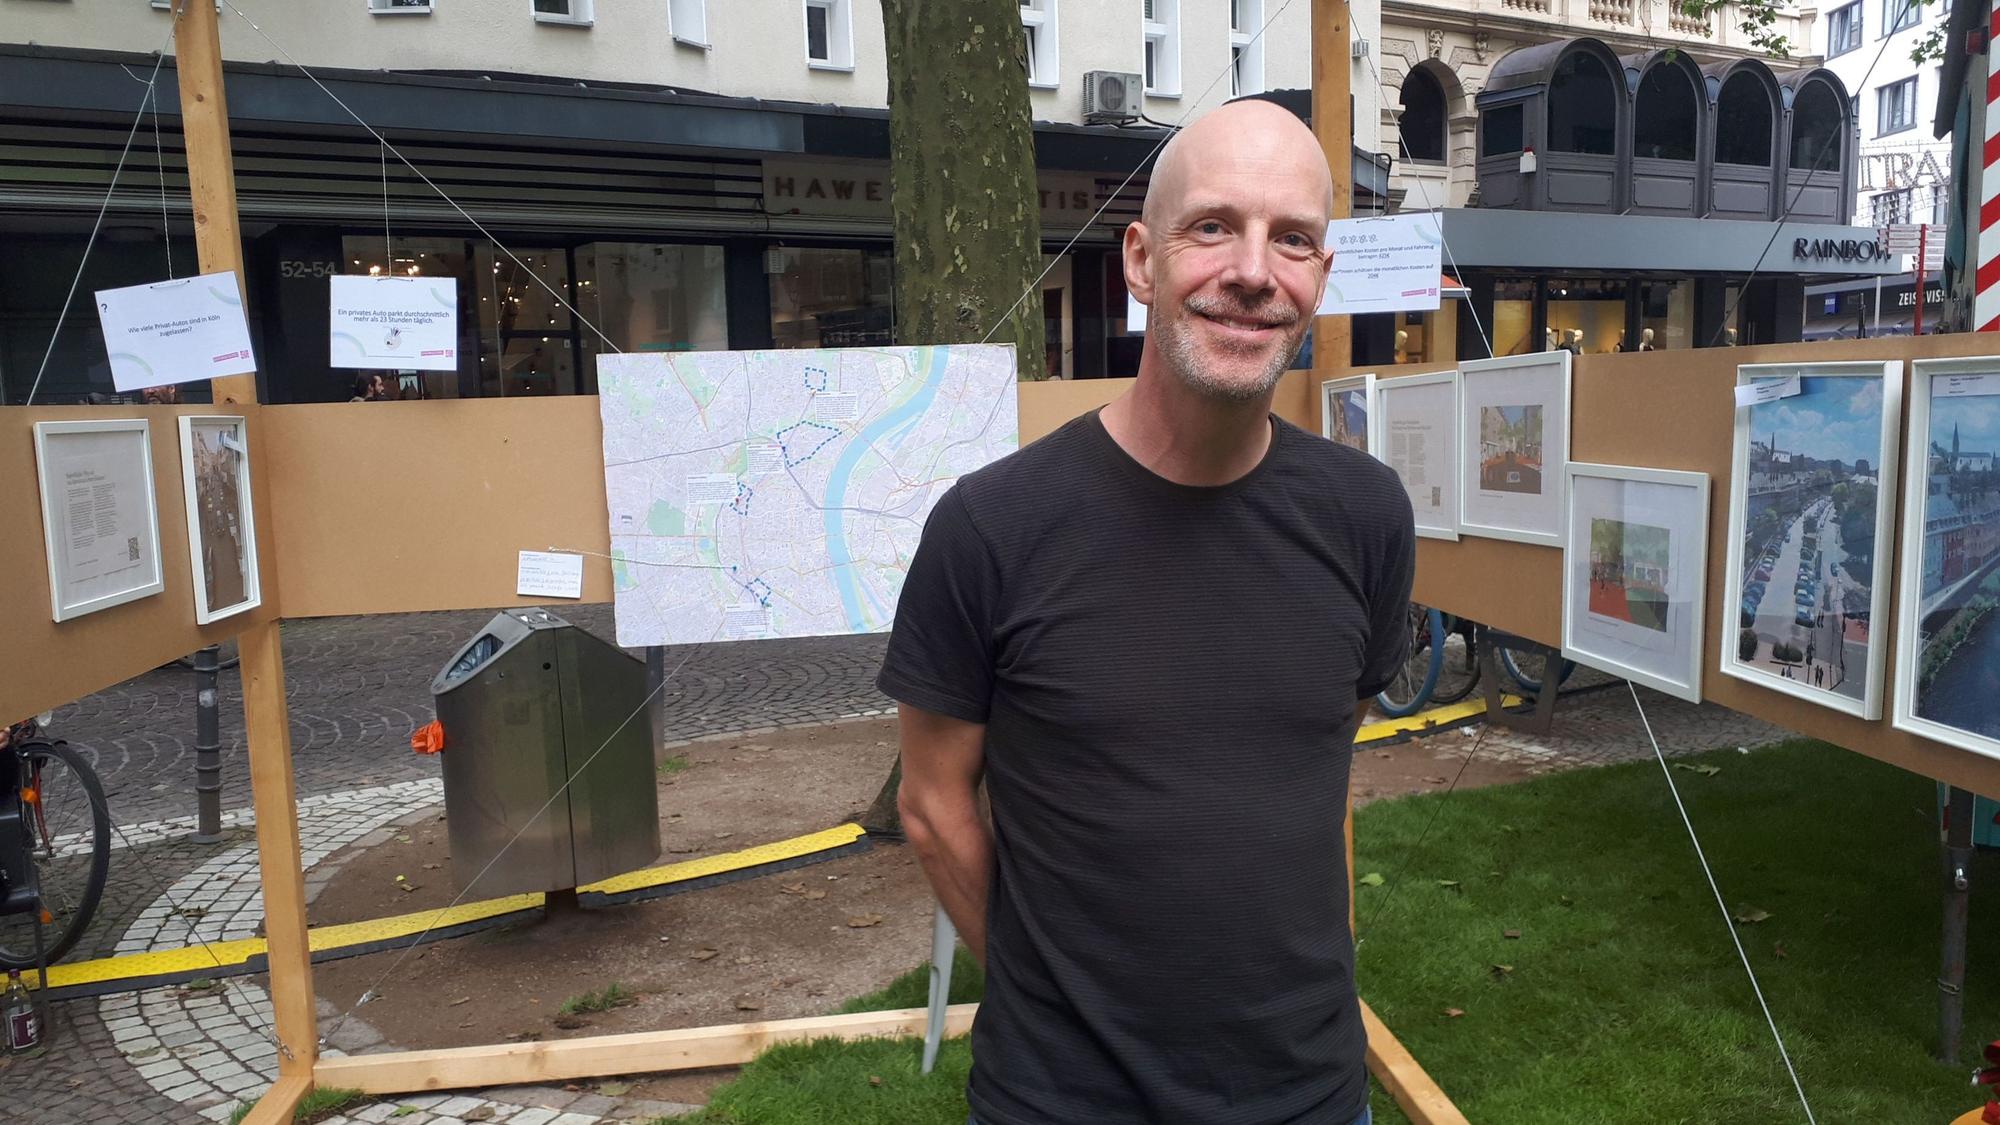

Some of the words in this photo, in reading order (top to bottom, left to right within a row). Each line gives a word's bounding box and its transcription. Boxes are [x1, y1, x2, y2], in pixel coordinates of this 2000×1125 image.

[774, 176, 883, 202] HAWE
[1795, 237, 1892, 262] RAINBOW
[280, 261, 337, 278] 52-54
[1898, 291, 1917, 306] ZEIS
[101, 303, 108, 313] ?
[338, 308, 347, 316] Ein
[348, 309, 372, 317] privates
[373, 309, 387, 317] Auto
[388, 310, 403, 318] parkt
[404, 310, 450, 318] durchschnittlich
[140, 324, 154, 332] viele
[154, 319, 189, 330] Privat-Autos
[189, 317, 201, 325] sind
[208, 313, 221, 321] Köln
[159, 326, 193, 337] zugelassen?
